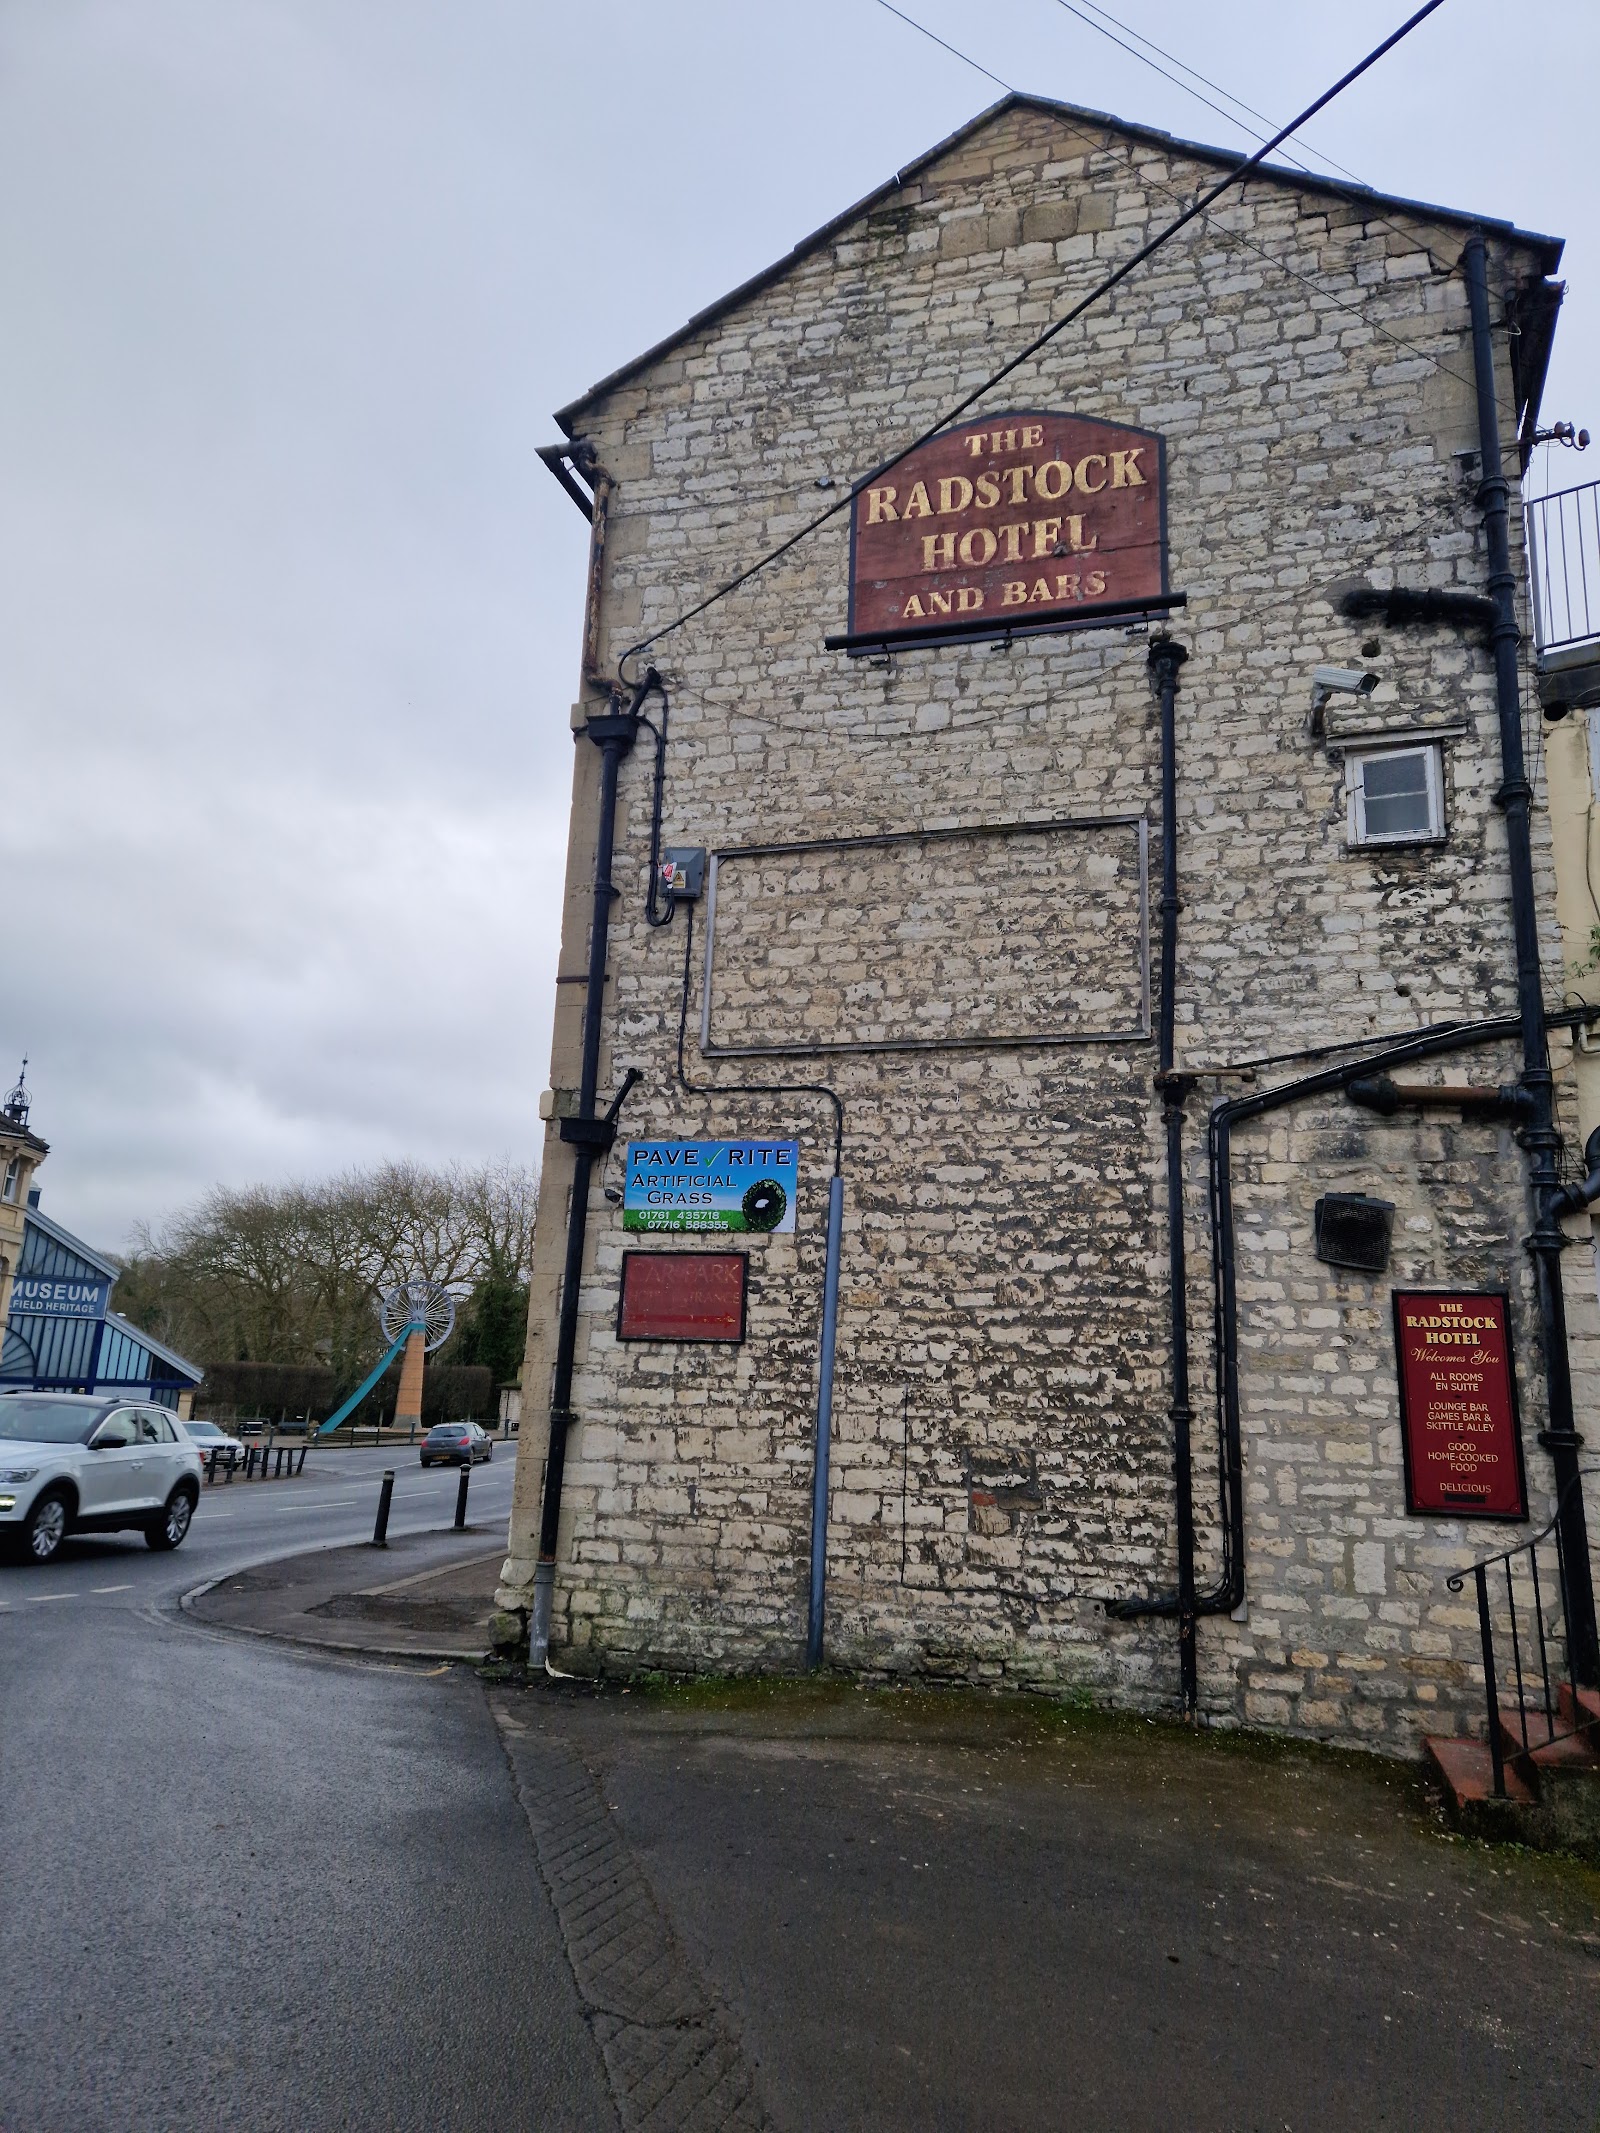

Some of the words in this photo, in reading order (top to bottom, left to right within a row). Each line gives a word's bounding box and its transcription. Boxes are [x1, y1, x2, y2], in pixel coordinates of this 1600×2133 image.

[965, 424, 1045, 457] THE
[865, 448, 1148, 525] RADSTOCK
[921, 513, 1097, 572] HOTEL
[902, 587, 985, 619] AND
[1001, 571, 1107, 607] BARS
[633, 1149, 699, 1166] PAVE
[728, 1149, 792, 1166] RITE
[631, 1173, 738, 1188] ARTIFICIAL
[647, 1190, 713, 1205] GRASS
[638, 1211, 670, 1220] 01761
[677, 1211, 720, 1220] 435718
[647, 1220, 680, 1230] 07716
[685, 1220, 729, 1230] 588355
[685, 1263, 740, 1284] PARK
[9, 1299, 43, 1310] FIELD
[46, 1302, 95, 1314] HERITAGE
[1439, 1303, 1464, 1313] THE
[1406, 1316, 1498, 1329] RADSTOCK
[1426, 1332, 1481, 1345] HOTEL
[1410, 1347, 1466, 1363] Welcomes
[1470, 1349, 1500, 1365] You
[1430, 1372, 1447, 1381] ALL
[1449, 1372, 1484, 1382] ROOMS
[1435, 1382, 1449, 1391] EN
[1450, 1382, 1479, 1392] SUITE
[1429, 1402, 1467, 1412] LOUNGE
[1469, 1402, 1489, 1412] BAR
[1428, 1411, 1460, 1421] GAMES
[1463, 1412, 1481, 1422] BAR
[1484, 1413, 1492, 1422] &
[1426, 1421, 1464, 1431] SKITTLE
[1466, 1422, 1495, 1432] ALLEY
[1447, 1442, 1477, 1452] GOOD
[1428, 1451, 1499, 1463] HOME-COOKED
[1450, 1462, 1477, 1472] FOOD
[1439, 1482, 1492, 1494] DELICIOUS
